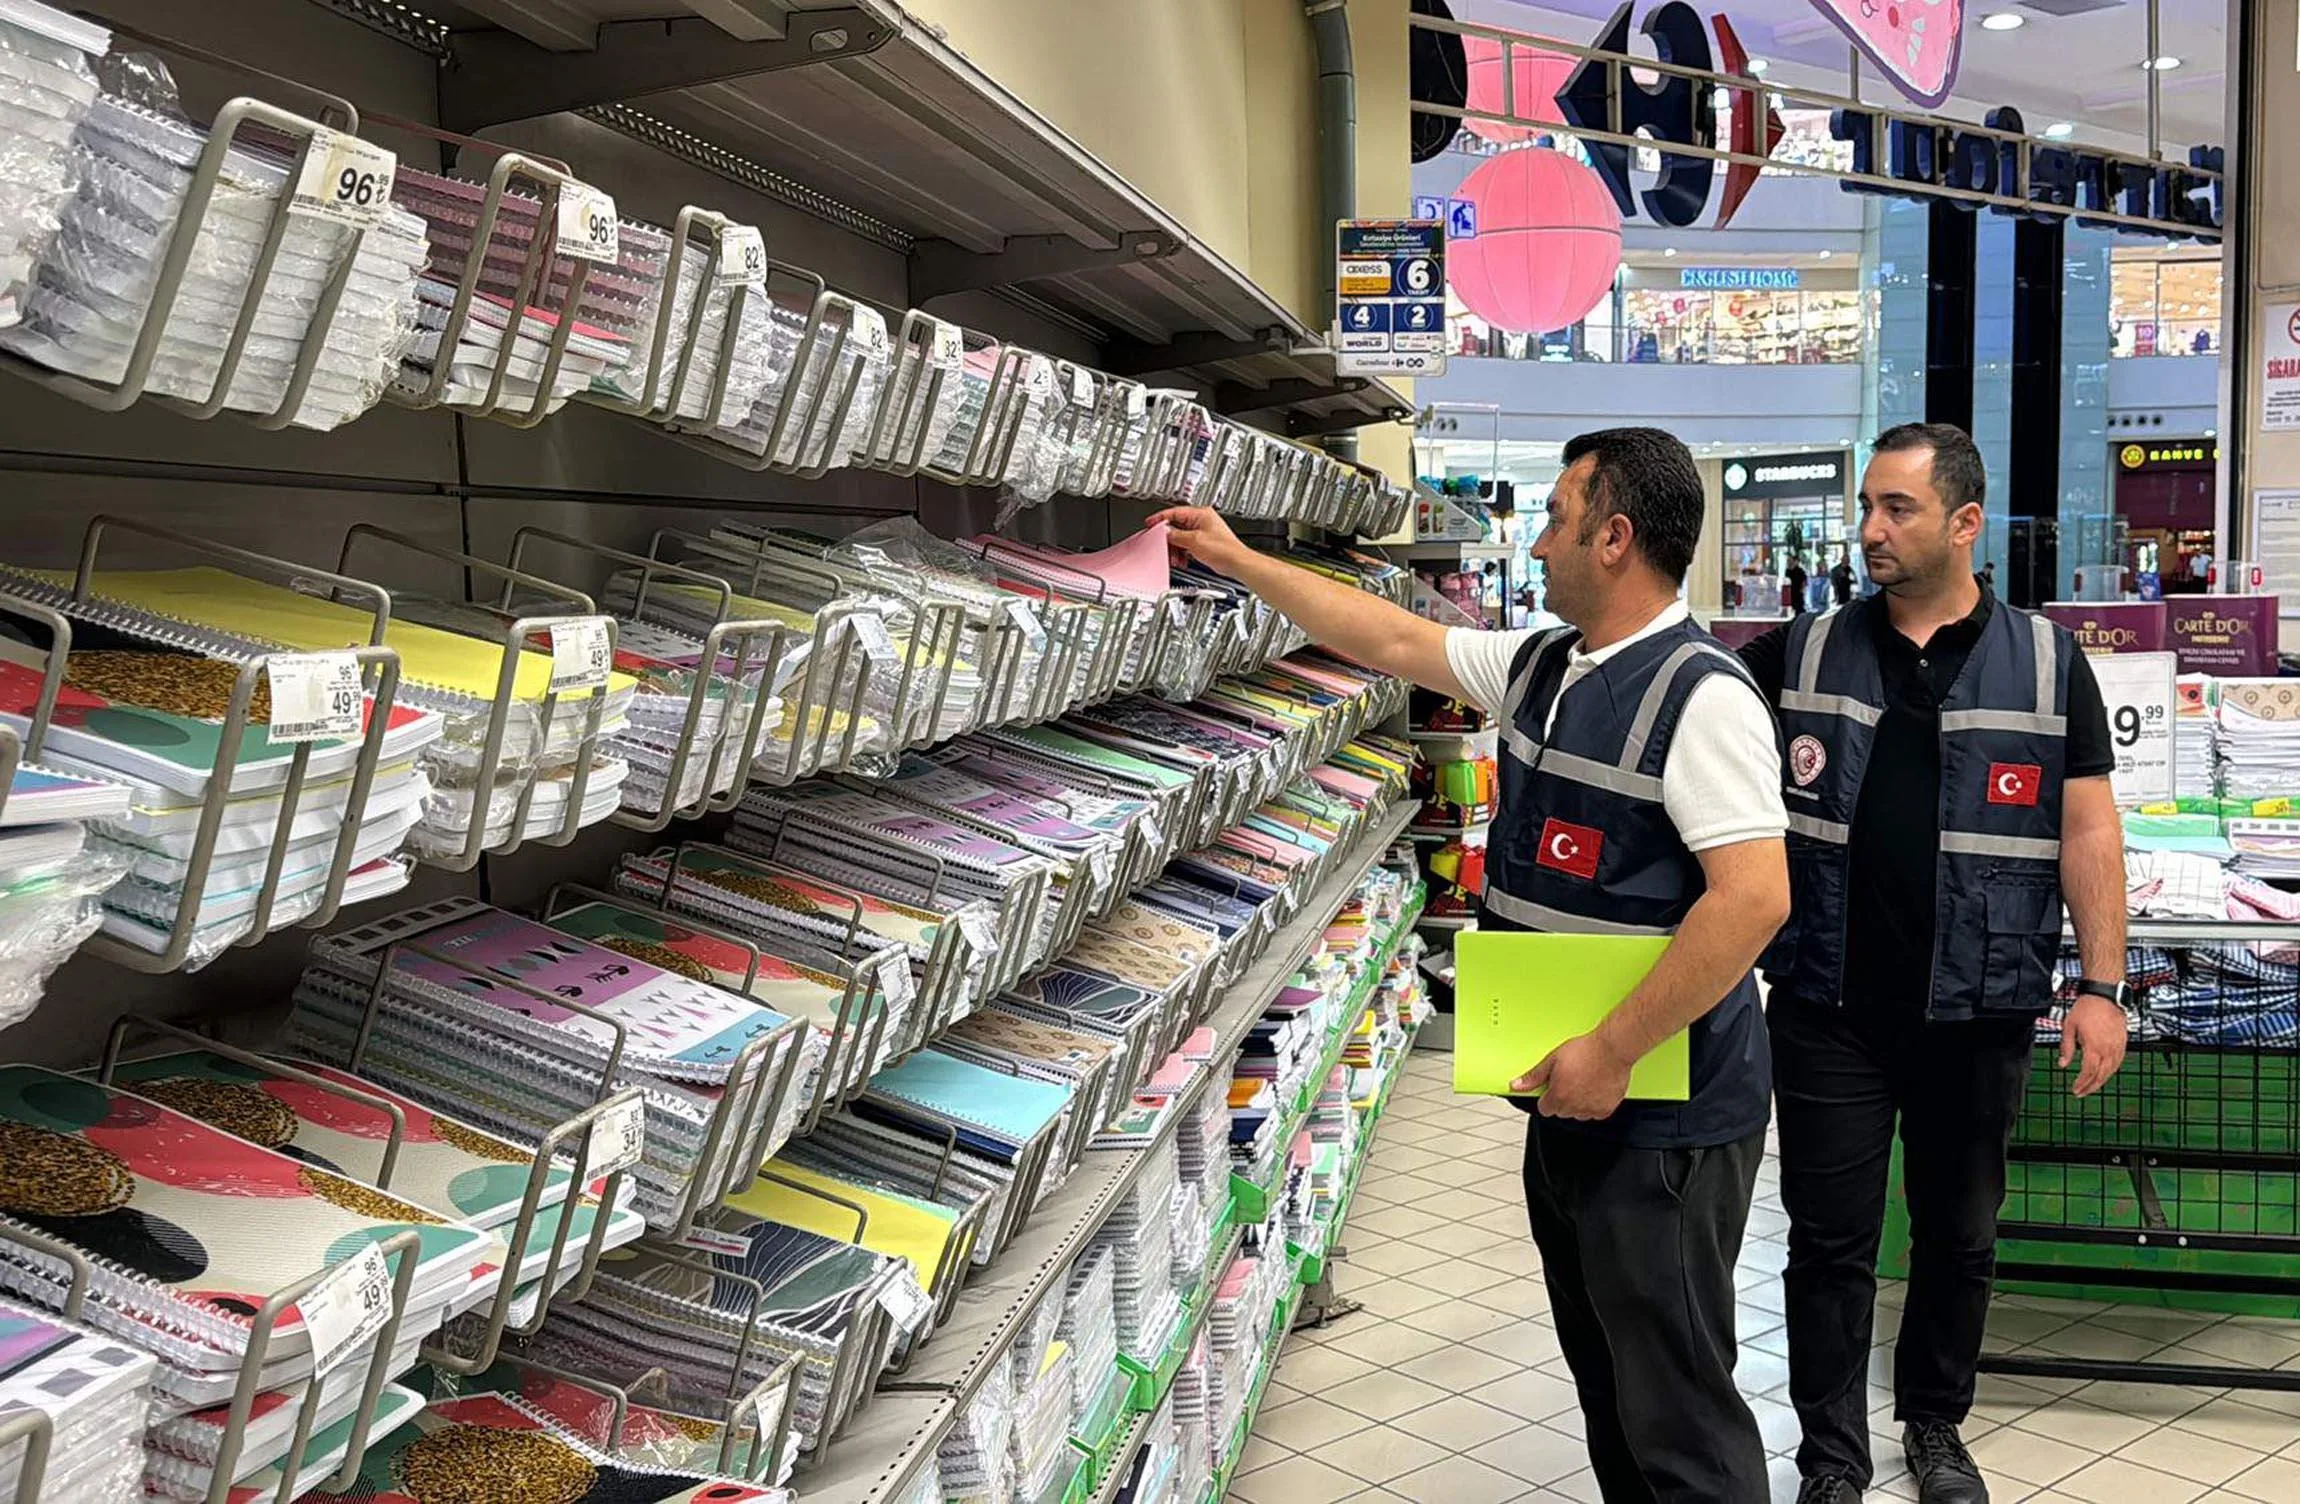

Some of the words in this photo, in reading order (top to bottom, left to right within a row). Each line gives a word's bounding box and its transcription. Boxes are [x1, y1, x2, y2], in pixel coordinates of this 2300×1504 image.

[337, 167, 374, 205] 96
[589, 214, 608, 244] 96
[745, 246, 759, 269] 82
[1407, 259, 1430, 290] 6
[1354, 305, 1370, 324] 4
[1411, 305, 1426, 323] 2
[1754, 463, 1837, 483] STARBUCKS
[2174, 617, 2213, 635] CARTE
[332, 691, 351, 714] 49
[364, 1283, 380, 1310] 49
